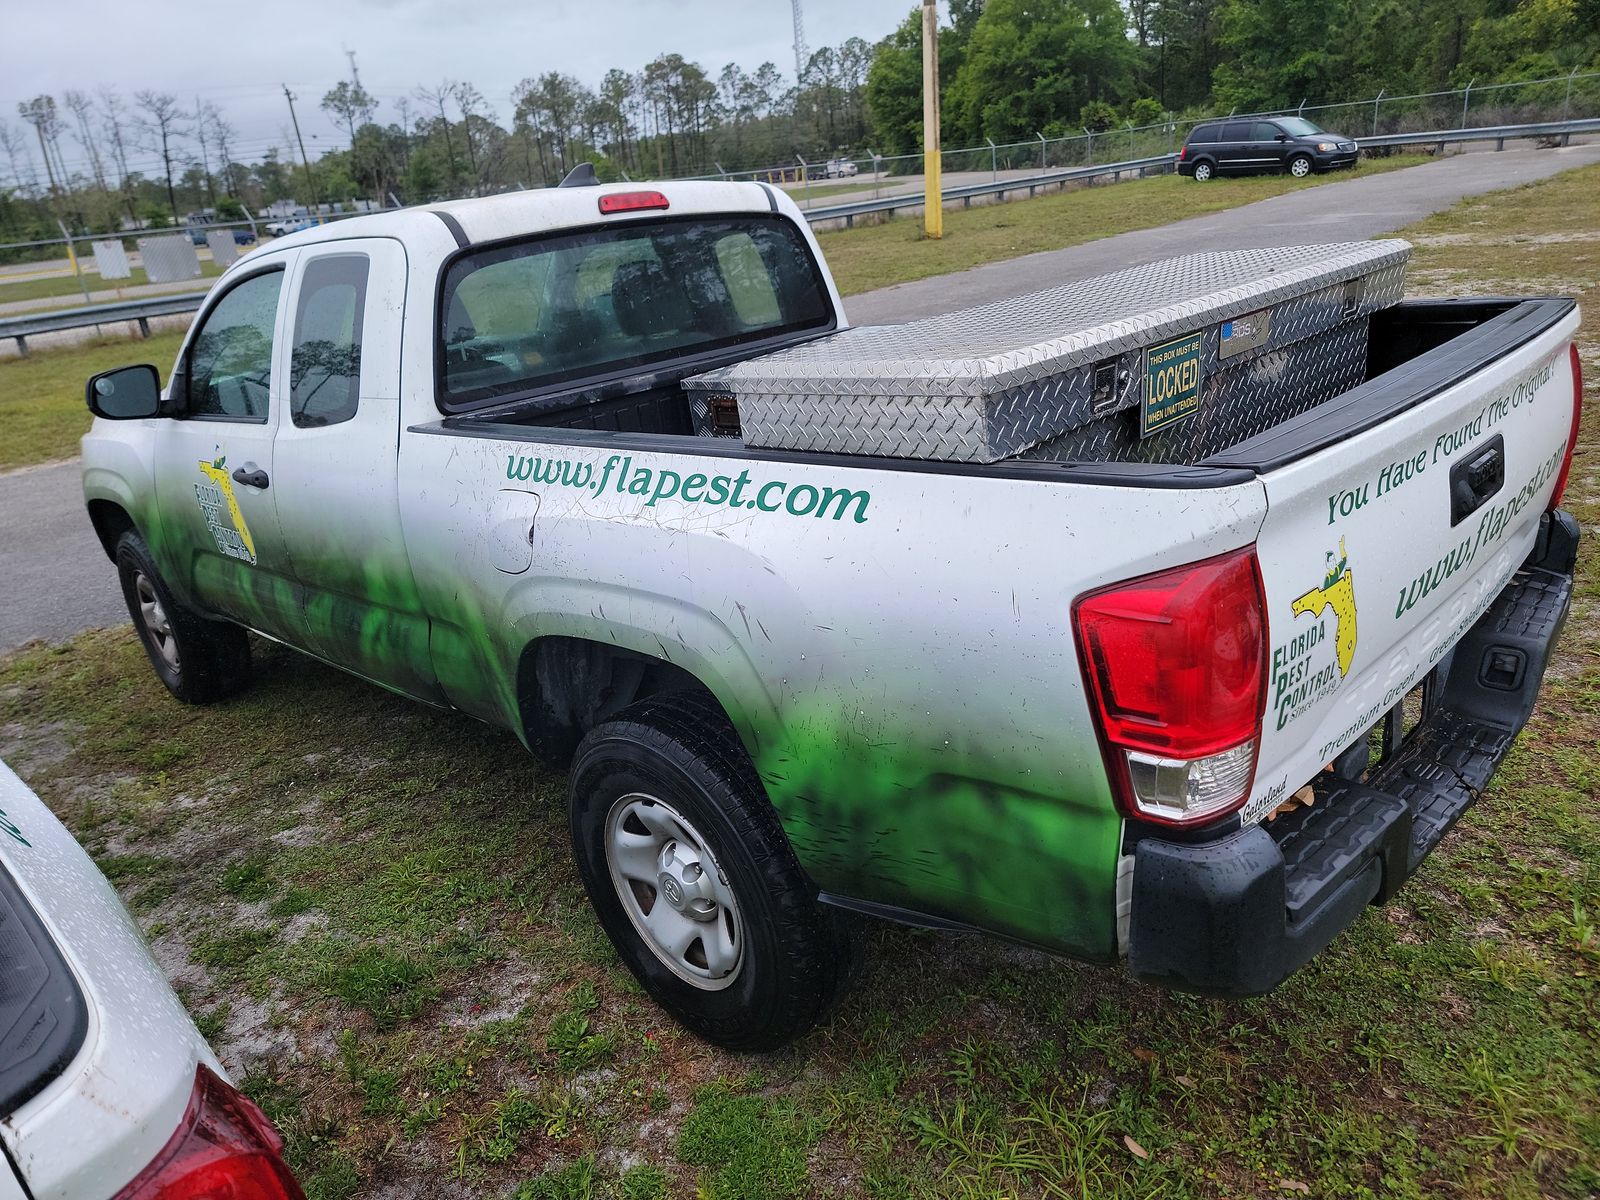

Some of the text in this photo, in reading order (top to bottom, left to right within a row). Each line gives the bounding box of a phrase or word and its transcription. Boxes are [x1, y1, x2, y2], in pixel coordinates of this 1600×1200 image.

[1150, 341, 1199, 366] THIS BOX MUST BE
[1149, 358, 1198, 405] LOCKED
[1148, 396, 1198, 424] WHEN UNATTENDED
[1328, 483, 1369, 525] You
[1376, 449, 1427, 499] Have
[1432, 412, 1484, 464] Found
[1487, 395, 1509, 428] The
[194, 483, 222, 508] FLORIDA
[506, 455, 871, 524] www.flapest.com
[201, 504, 221, 531] PEST
[1395, 440, 1567, 619] www.flapest.com
[1272, 620, 1325, 685] FLORIDA
[1429, 631, 1457, 663] Green
[1457, 600, 1483, 636] Shield
[1274, 655, 1312, 710] PEST
[1276, 661, 1336, 731] CONTROL
[1242, 774, 1288, 823] Gatorland
